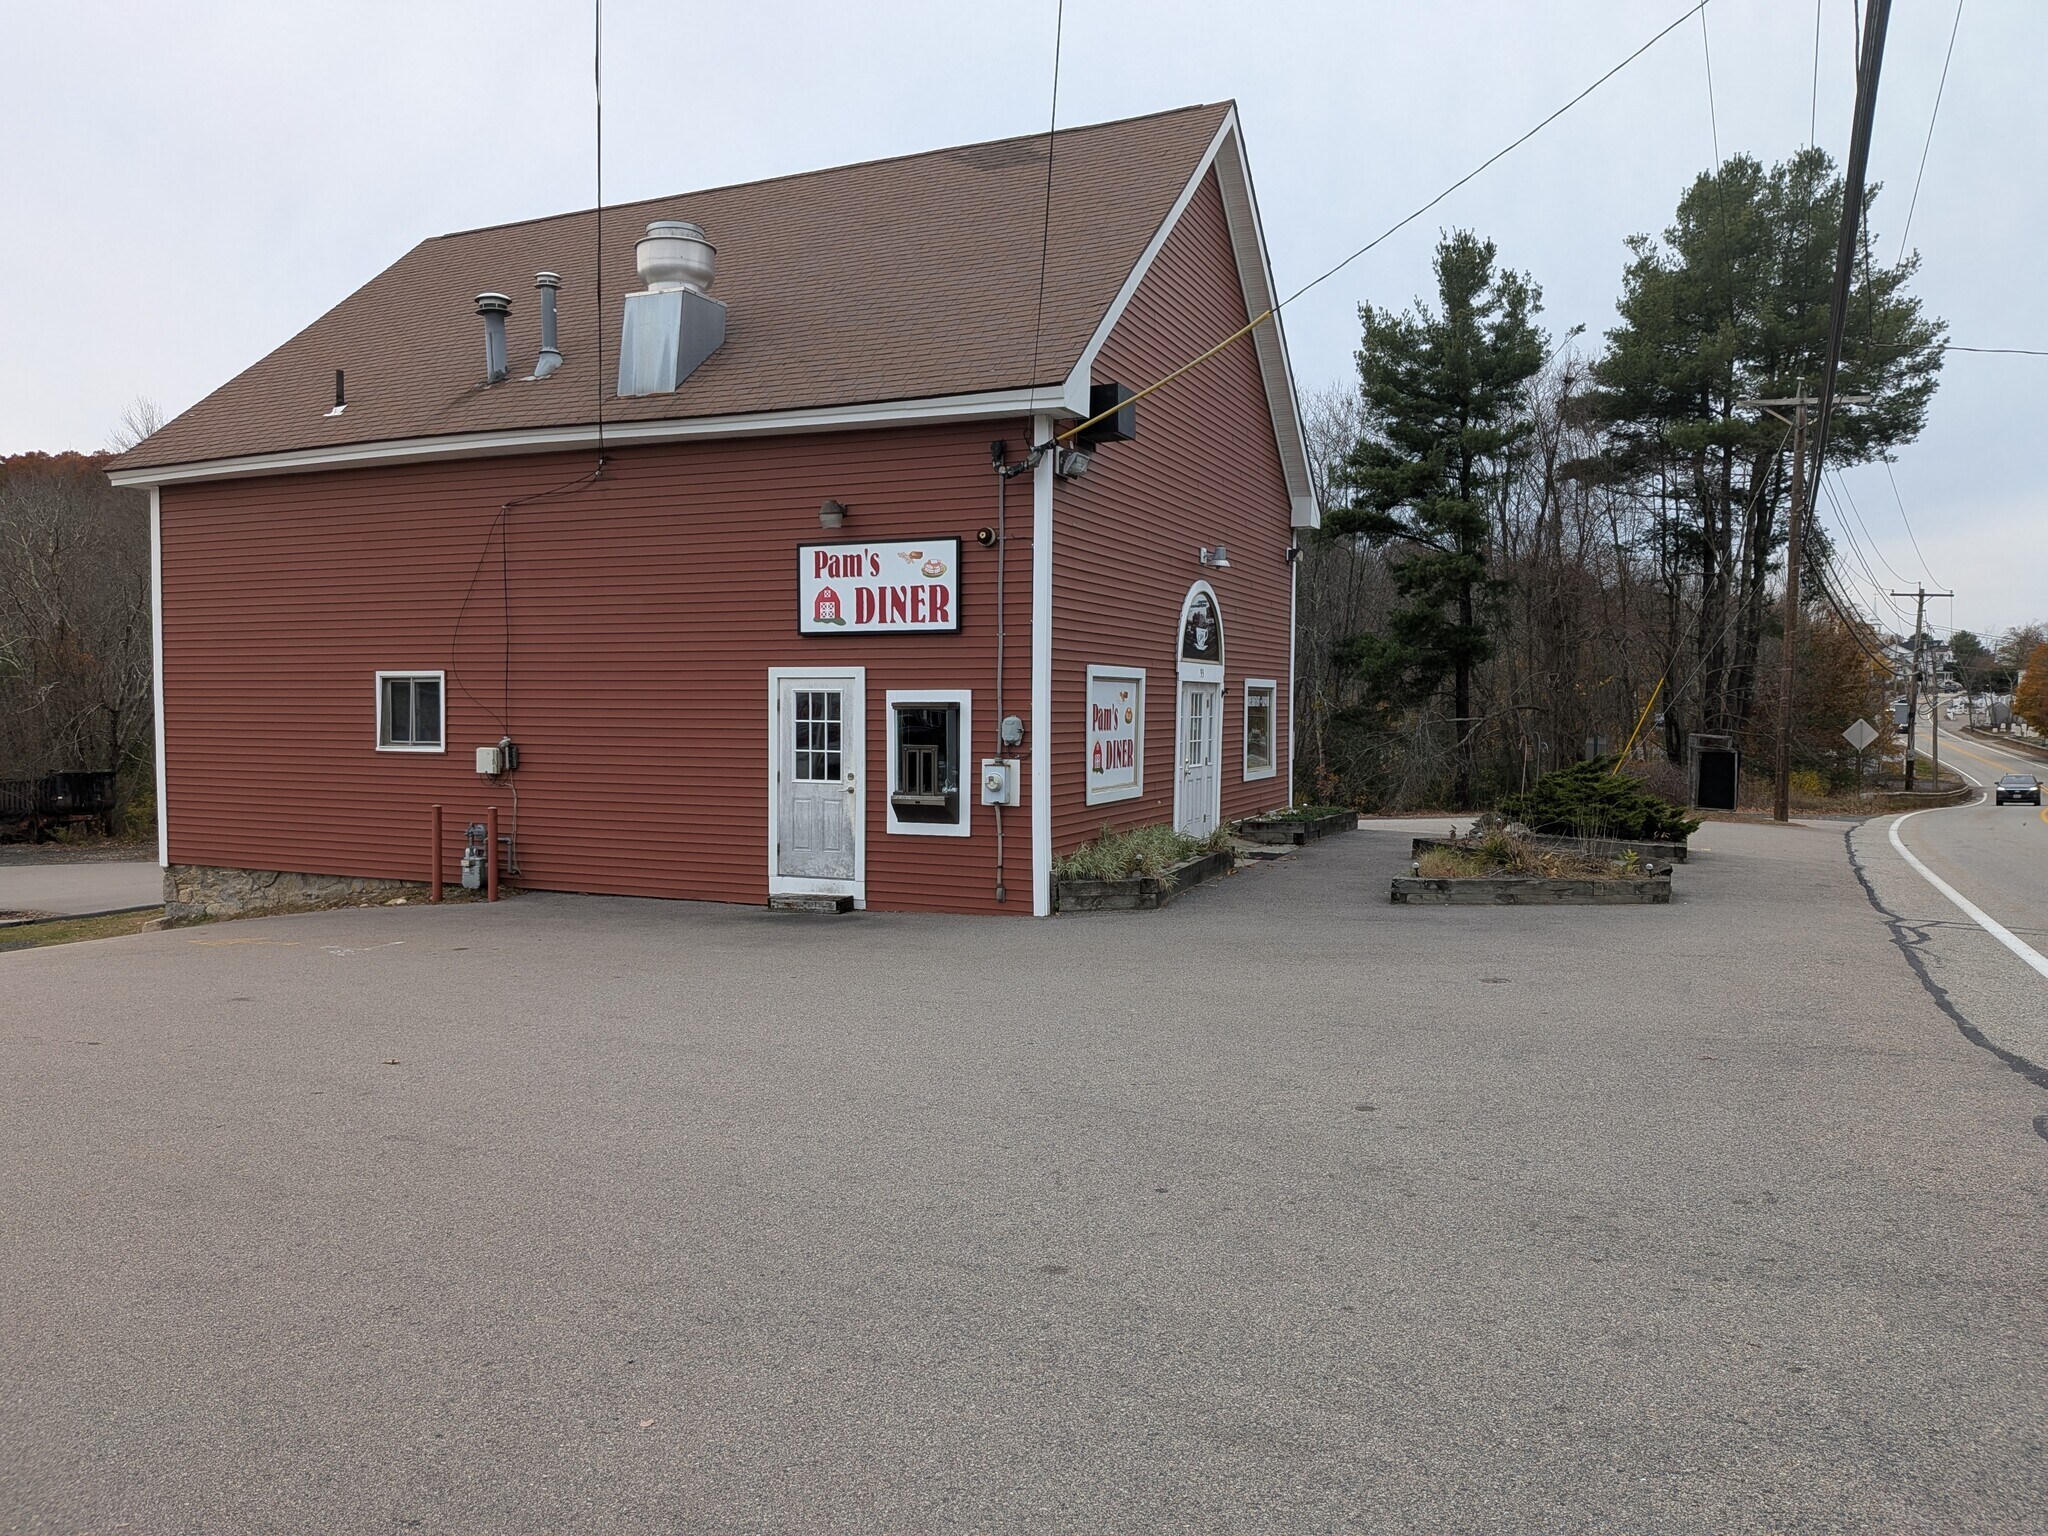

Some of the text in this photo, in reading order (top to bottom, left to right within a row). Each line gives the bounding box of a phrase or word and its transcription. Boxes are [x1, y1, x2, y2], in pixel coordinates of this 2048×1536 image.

[814, 548, 880, 579] Pam's
[854, 584, 950, 625] DINER
[1092, 703, 1119, 732] Pam's
[1105, 739, 1133, 770] DINER
